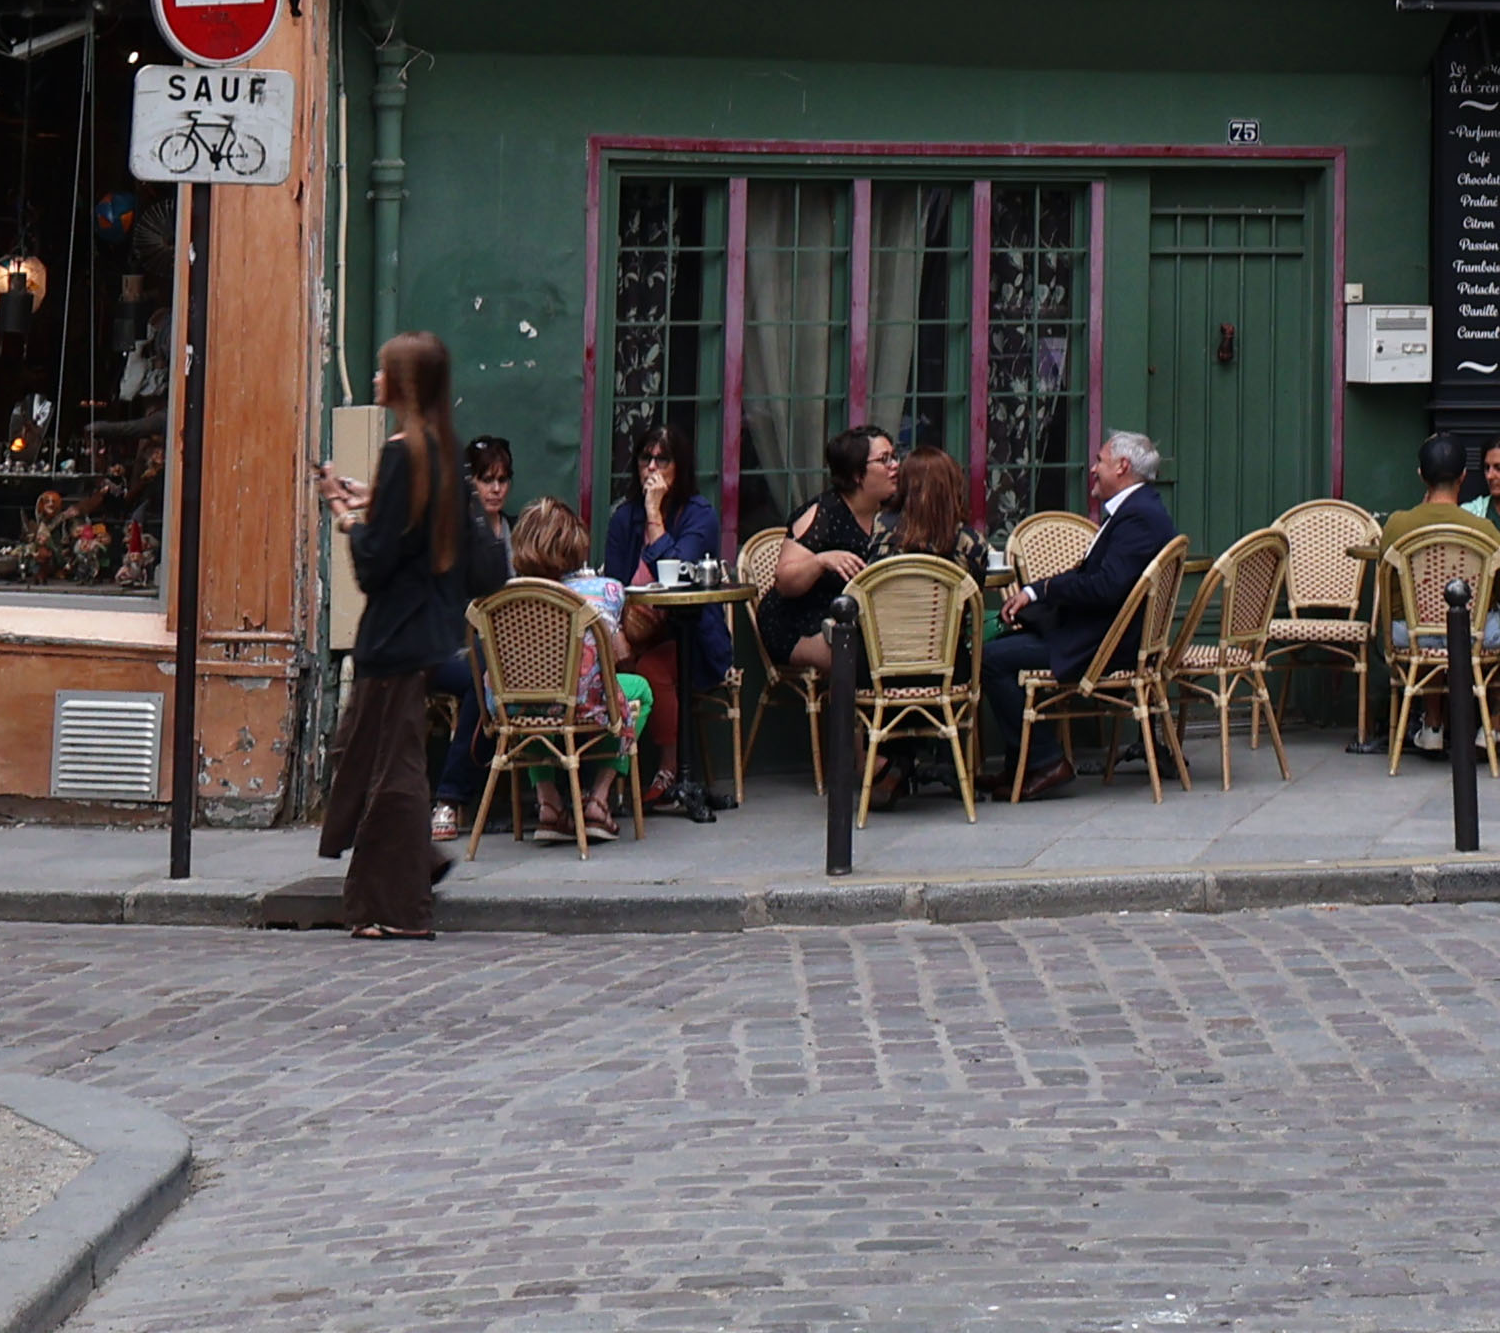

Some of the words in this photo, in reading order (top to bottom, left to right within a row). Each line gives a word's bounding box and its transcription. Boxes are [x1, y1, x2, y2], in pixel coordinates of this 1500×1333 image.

[167, 73, 267, 103] SAUF
[1449, 80, 1457, 93] à
[1460, 79, 1472, 94] la
[1232, 123, 1256, 141] 75
[1468, 151, 1490, 166] Café
[1457, 172, 1500, 186] Chocolat
[1460, 194, 1498, 208] Praliné
[1463, 215, 1495, 230] Citron
[1459, 238, 1499, 252] Passion
[1457, 281, 1500, 296] Pistache
[1458, 303, 1498, 317] Vanille
[1457, 325, 1500, 339] Caramel
